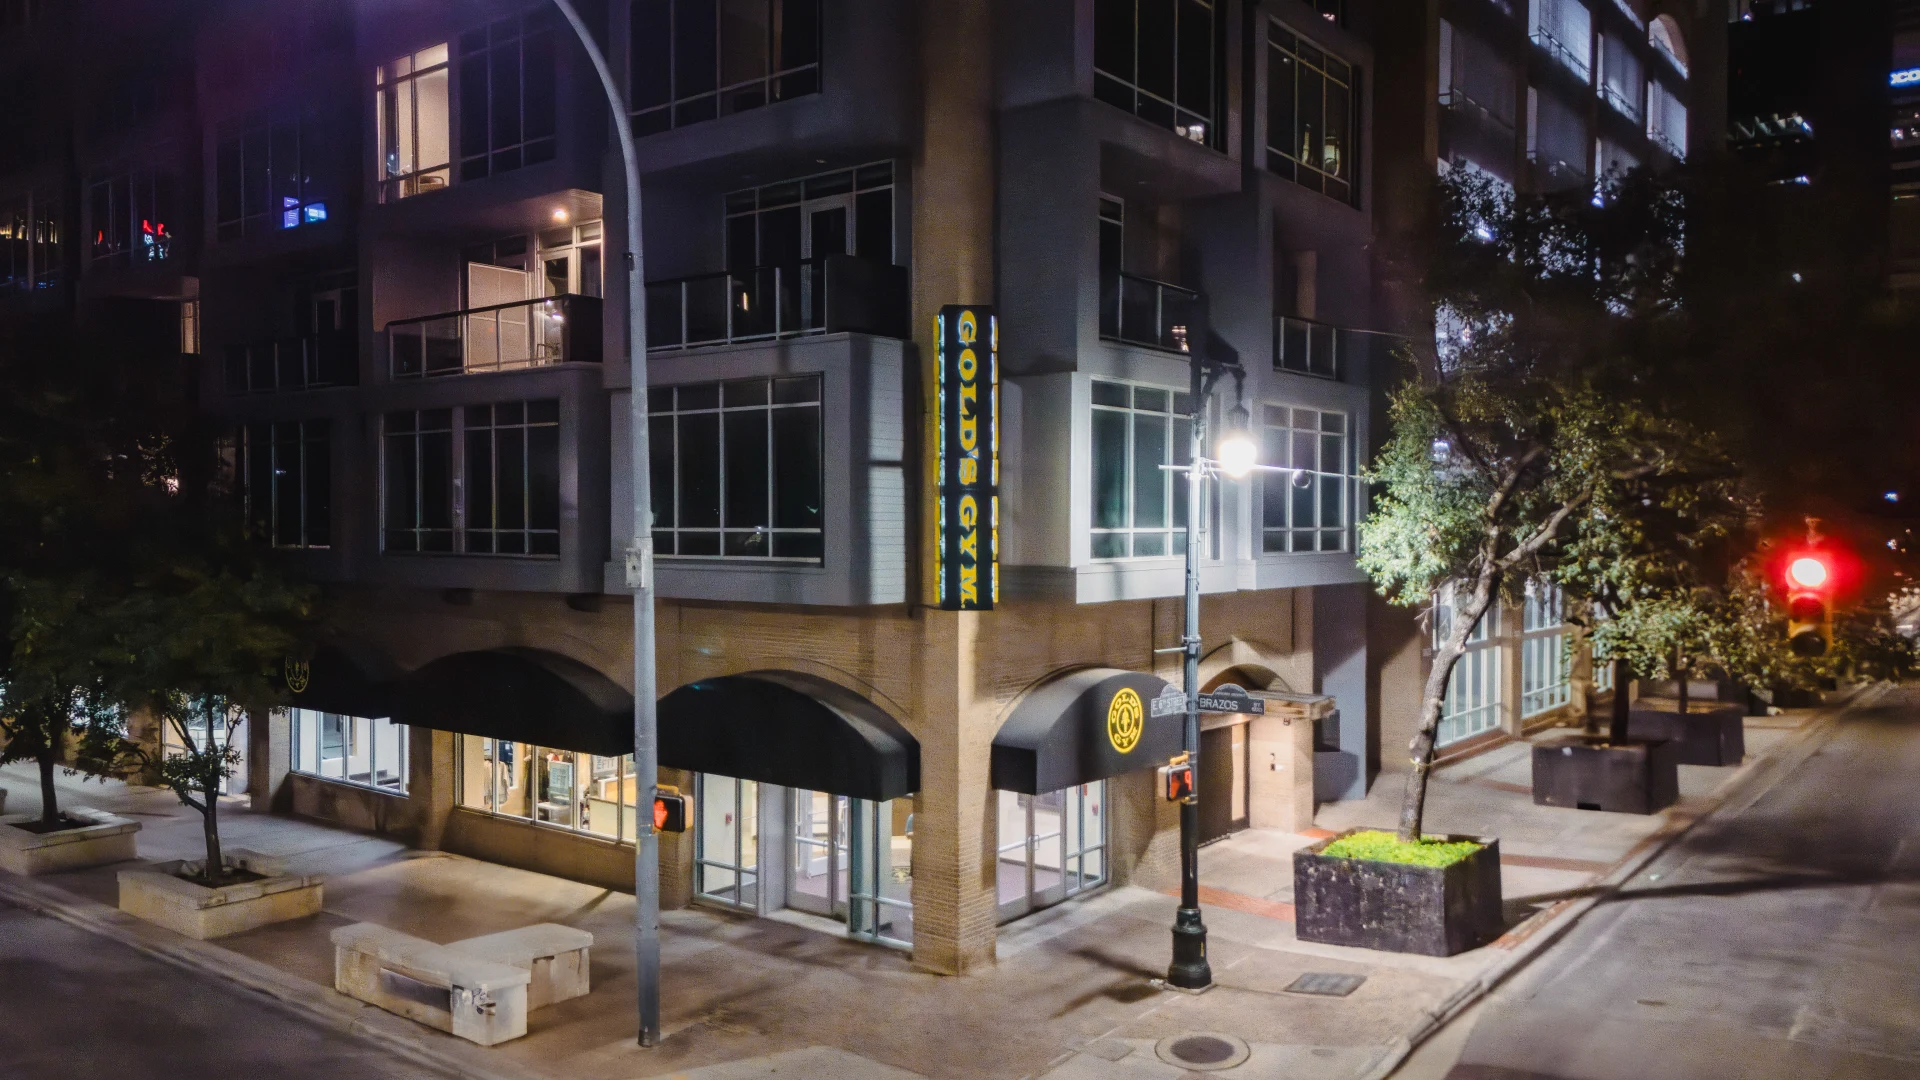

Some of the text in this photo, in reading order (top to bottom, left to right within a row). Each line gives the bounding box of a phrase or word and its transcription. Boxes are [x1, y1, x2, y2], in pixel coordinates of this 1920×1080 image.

[957, 310, 979, 606] GOLD'S GYM
[1199, 697, 1238, 711] BRAZOS
[1114, 726, 1138, 747] GYM
